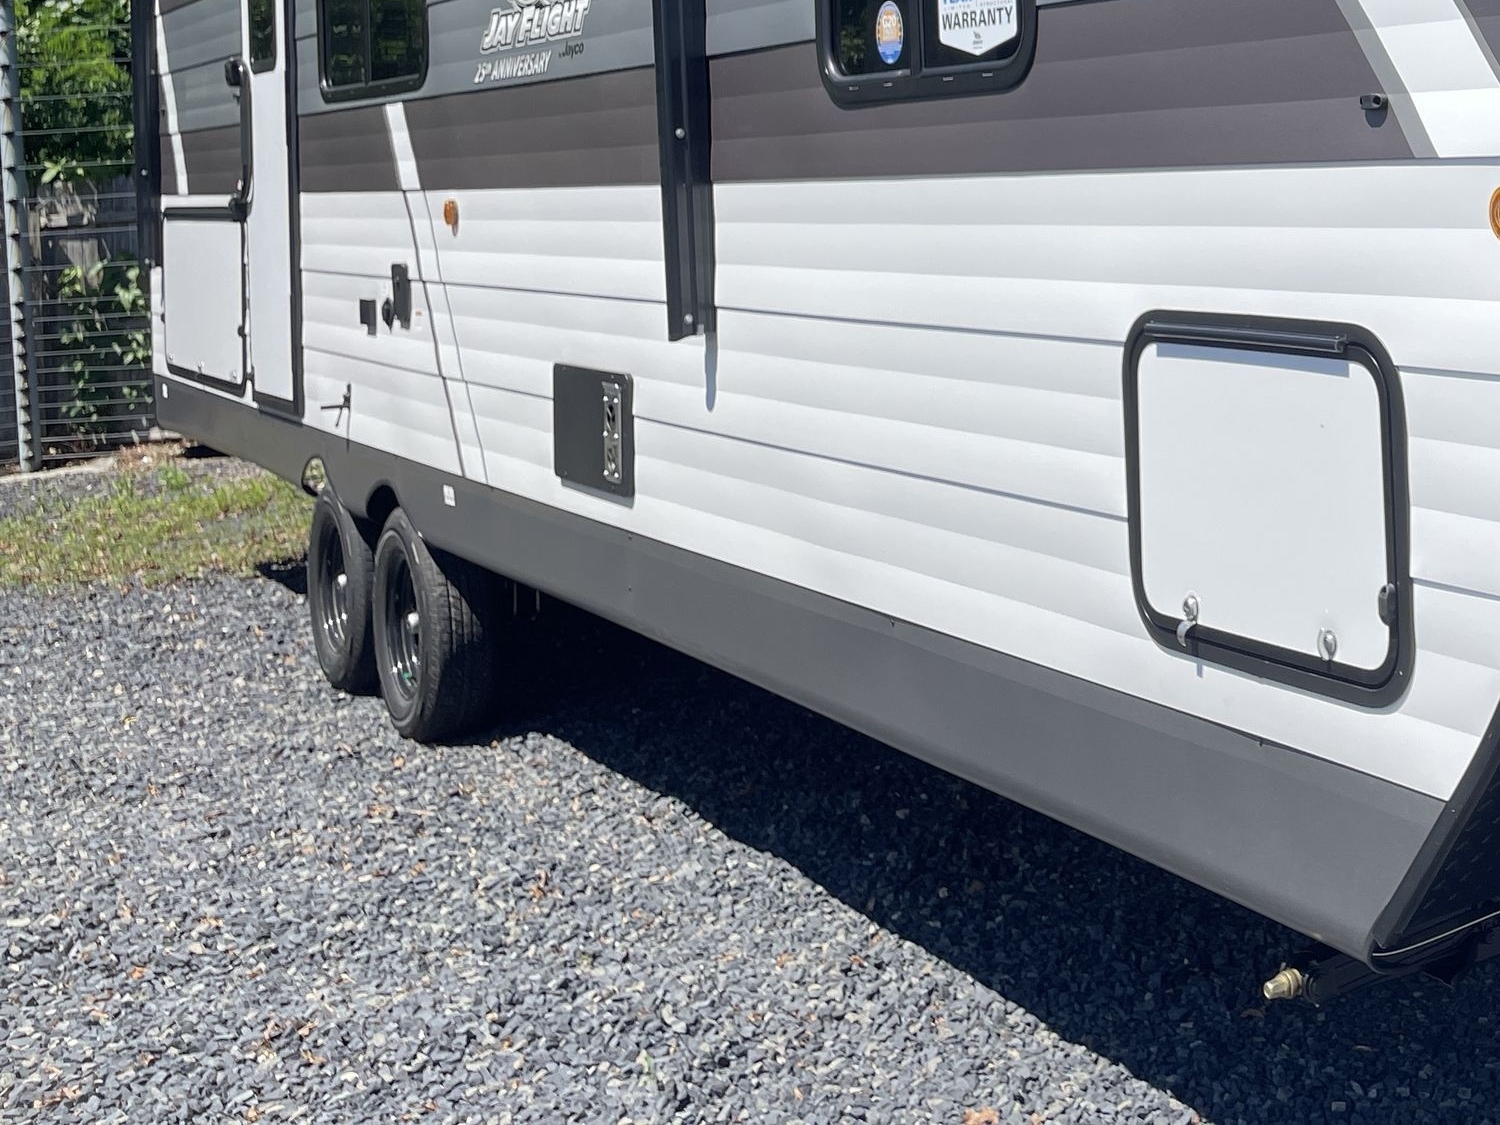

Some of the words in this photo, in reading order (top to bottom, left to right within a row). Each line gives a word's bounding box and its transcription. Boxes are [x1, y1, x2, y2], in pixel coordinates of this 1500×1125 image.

[481, 8, 521, 53] JAY
[942, 6, 1013, 30] WARRANTY
[490, 50, 552, 81] ANNIVERSARY
